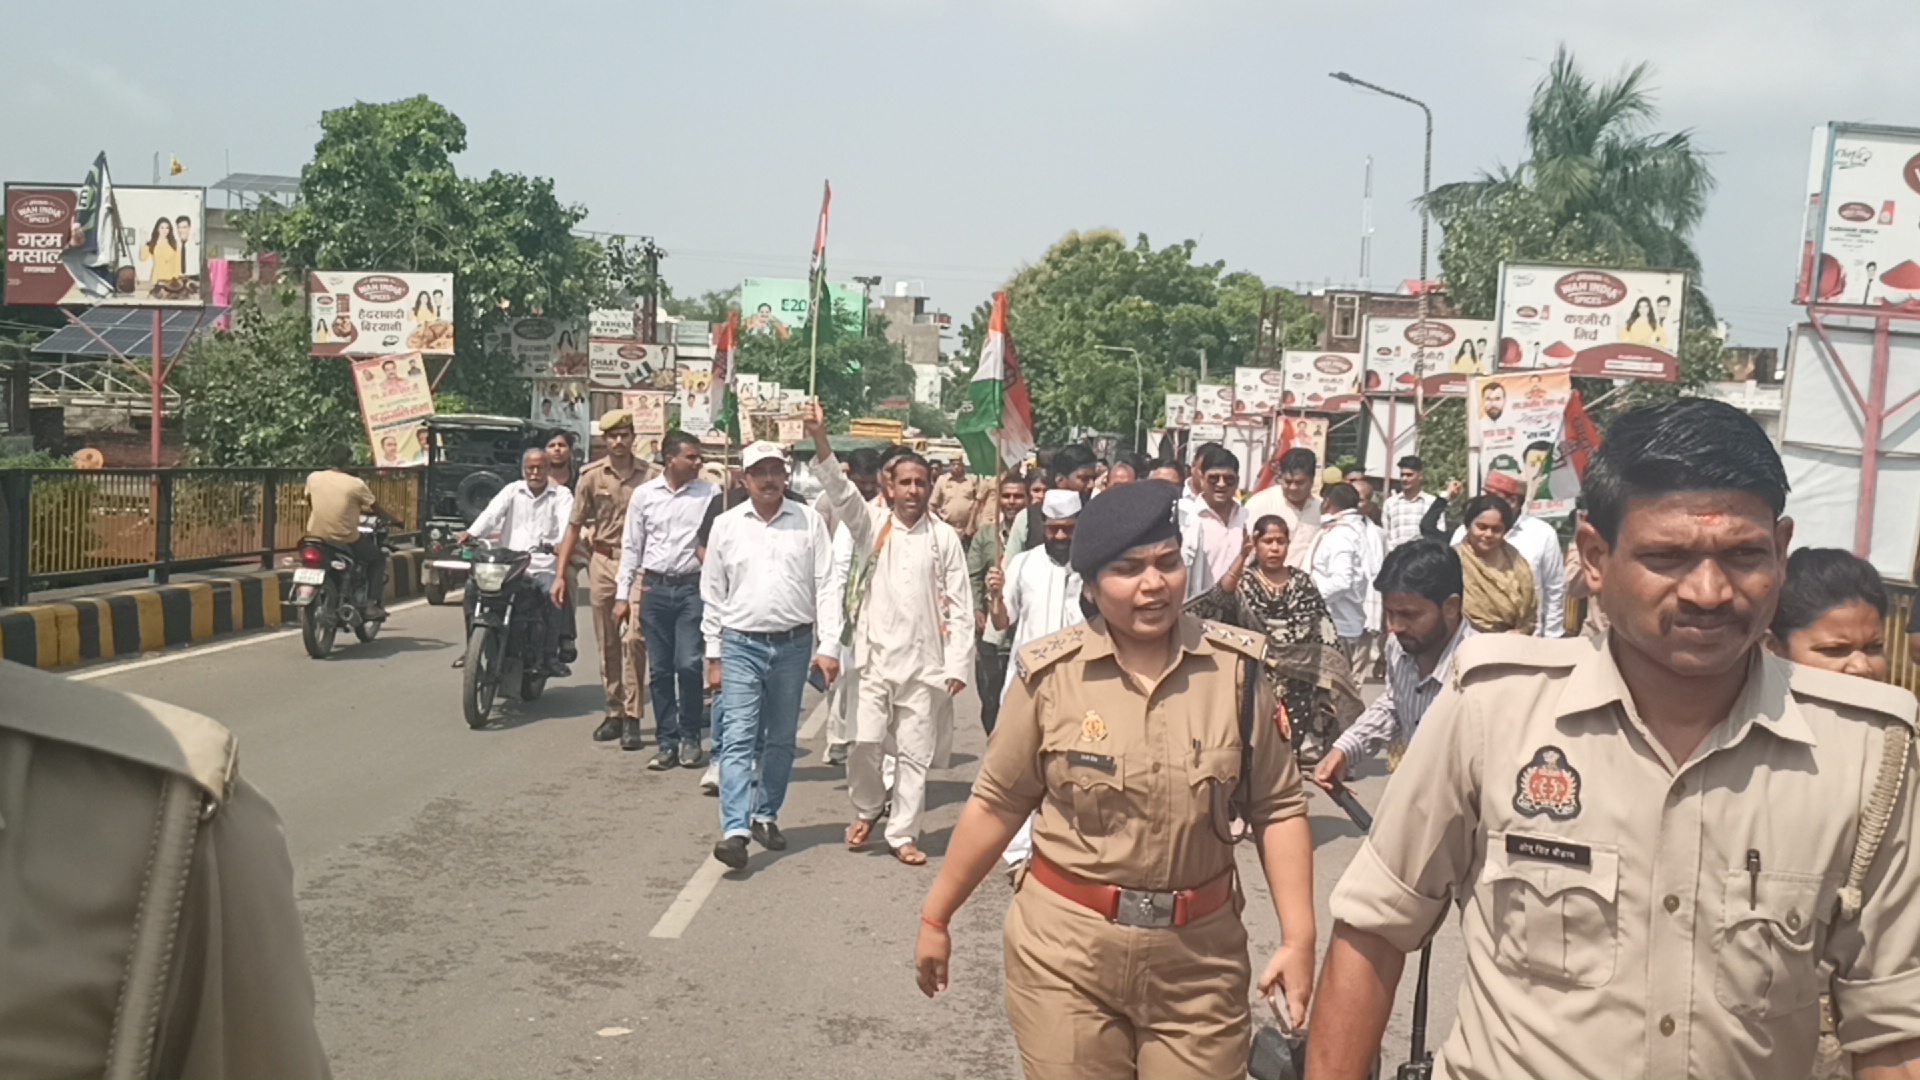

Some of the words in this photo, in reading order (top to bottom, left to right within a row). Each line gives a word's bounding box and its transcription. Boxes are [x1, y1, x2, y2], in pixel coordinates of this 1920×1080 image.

[17, 206, 39, 217] WAH
[39, 206, 61, 218] INDIA
[17, 232, 63, 248] गरम
[7, 248, 63, 264] मसाल
[1560, 281, 1588, 294] WAH
[1588, 281, 1619, 300] INDIA
[781, 298, 807, 312] E20
[358, 308, 405, 320] हैदराबादी
[1564, 312, 1612, 327] कश्मीरी
